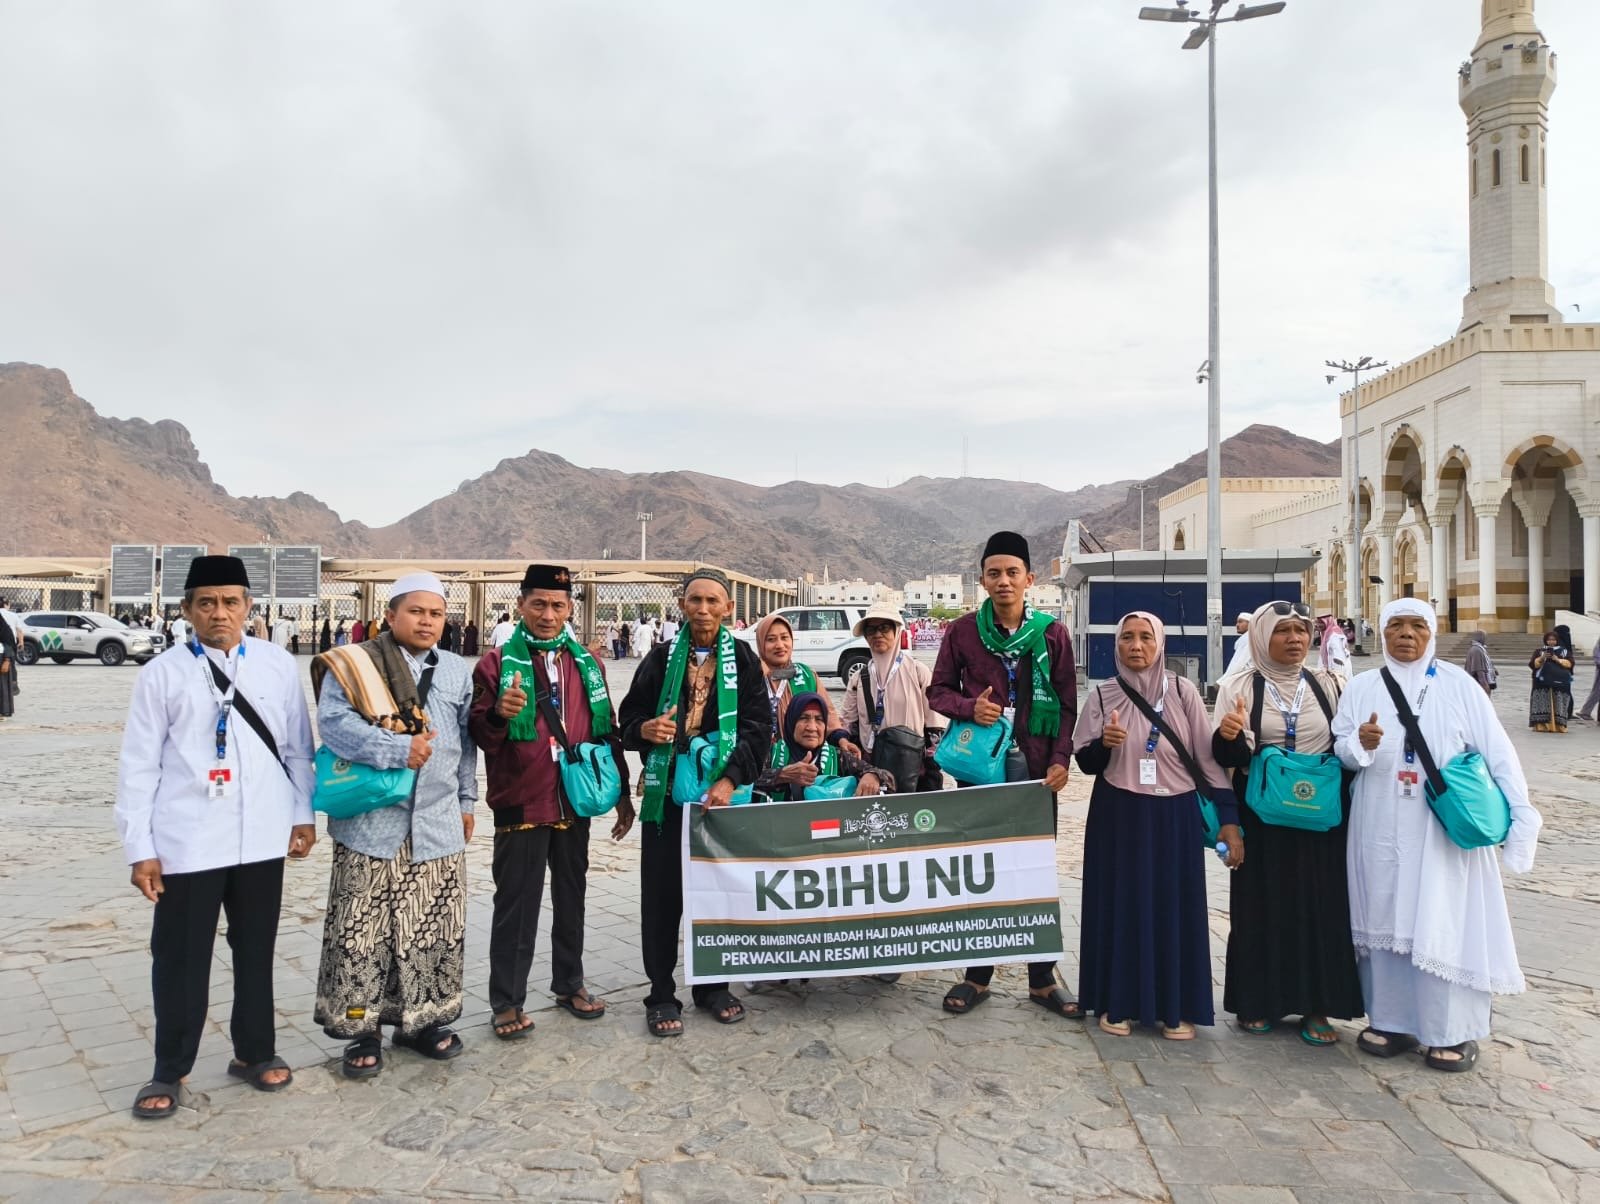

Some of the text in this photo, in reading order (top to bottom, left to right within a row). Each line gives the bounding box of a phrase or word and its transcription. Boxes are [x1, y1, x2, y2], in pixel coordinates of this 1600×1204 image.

[889, 831, 896, 839] U
[755, 852, 995, 911] KBIHU NU
[697, 914, 1056, 946] KELOMPOK BIMBINGAN IBADAH HAJI DAN UMRAH NAHDLATUL ULAMA
[722, 933, 1034, 966] PERWAKILAN RESMI KBIHU PCNU KEBUMEN
